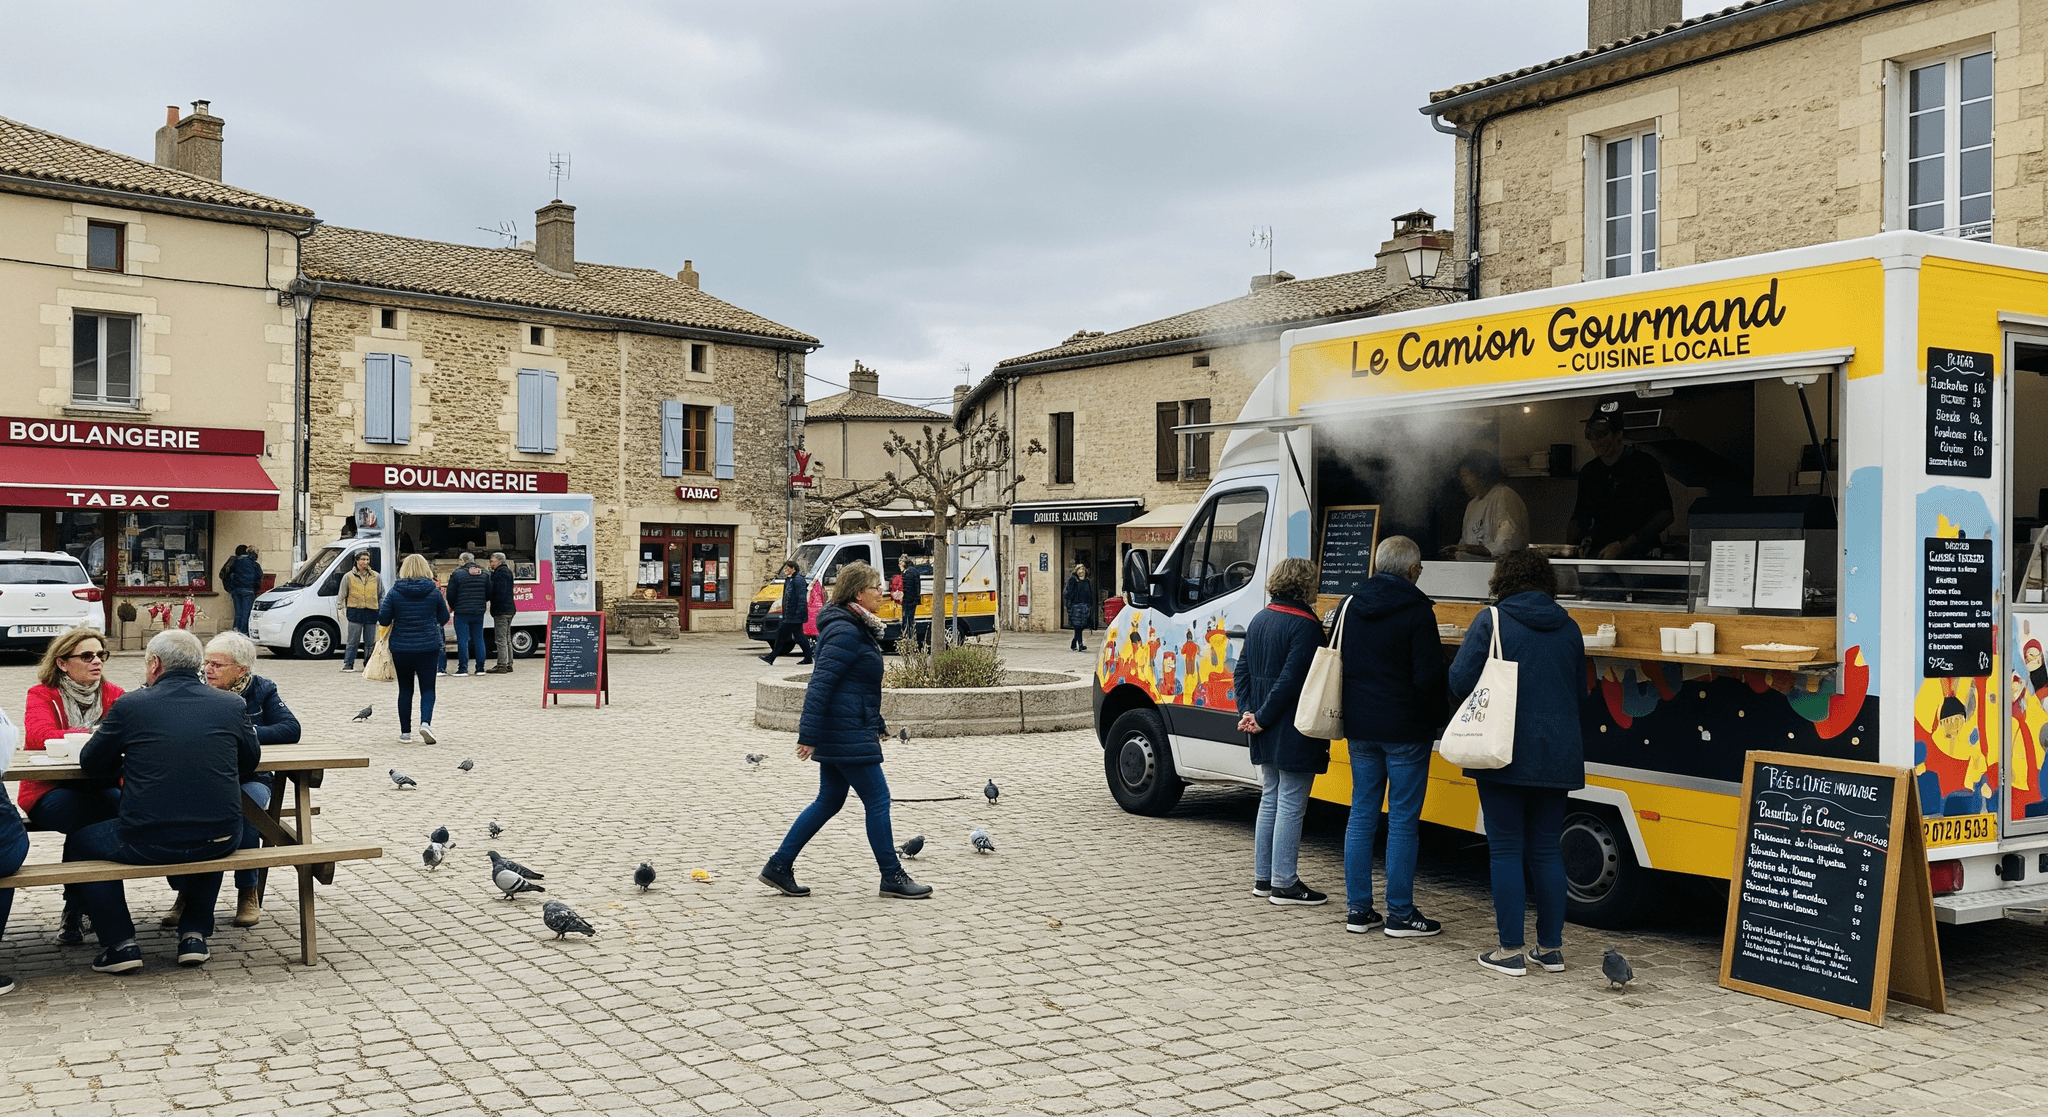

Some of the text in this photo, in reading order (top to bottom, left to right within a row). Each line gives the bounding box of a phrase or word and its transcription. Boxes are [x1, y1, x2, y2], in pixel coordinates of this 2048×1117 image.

[1351, 277, 1787, 378] Le Camion Gourmand
[1572, 345, 1655, 372] CUISINE
[1662, 334, 1750, 363] LOCALE
[9, 421, 200, 449] BOULANGERIE
[384, 467, 538, 492] BOULANGERIE
[66, 492, 170, 508] TABAC
[680, 487, 718, 499] TABAC
